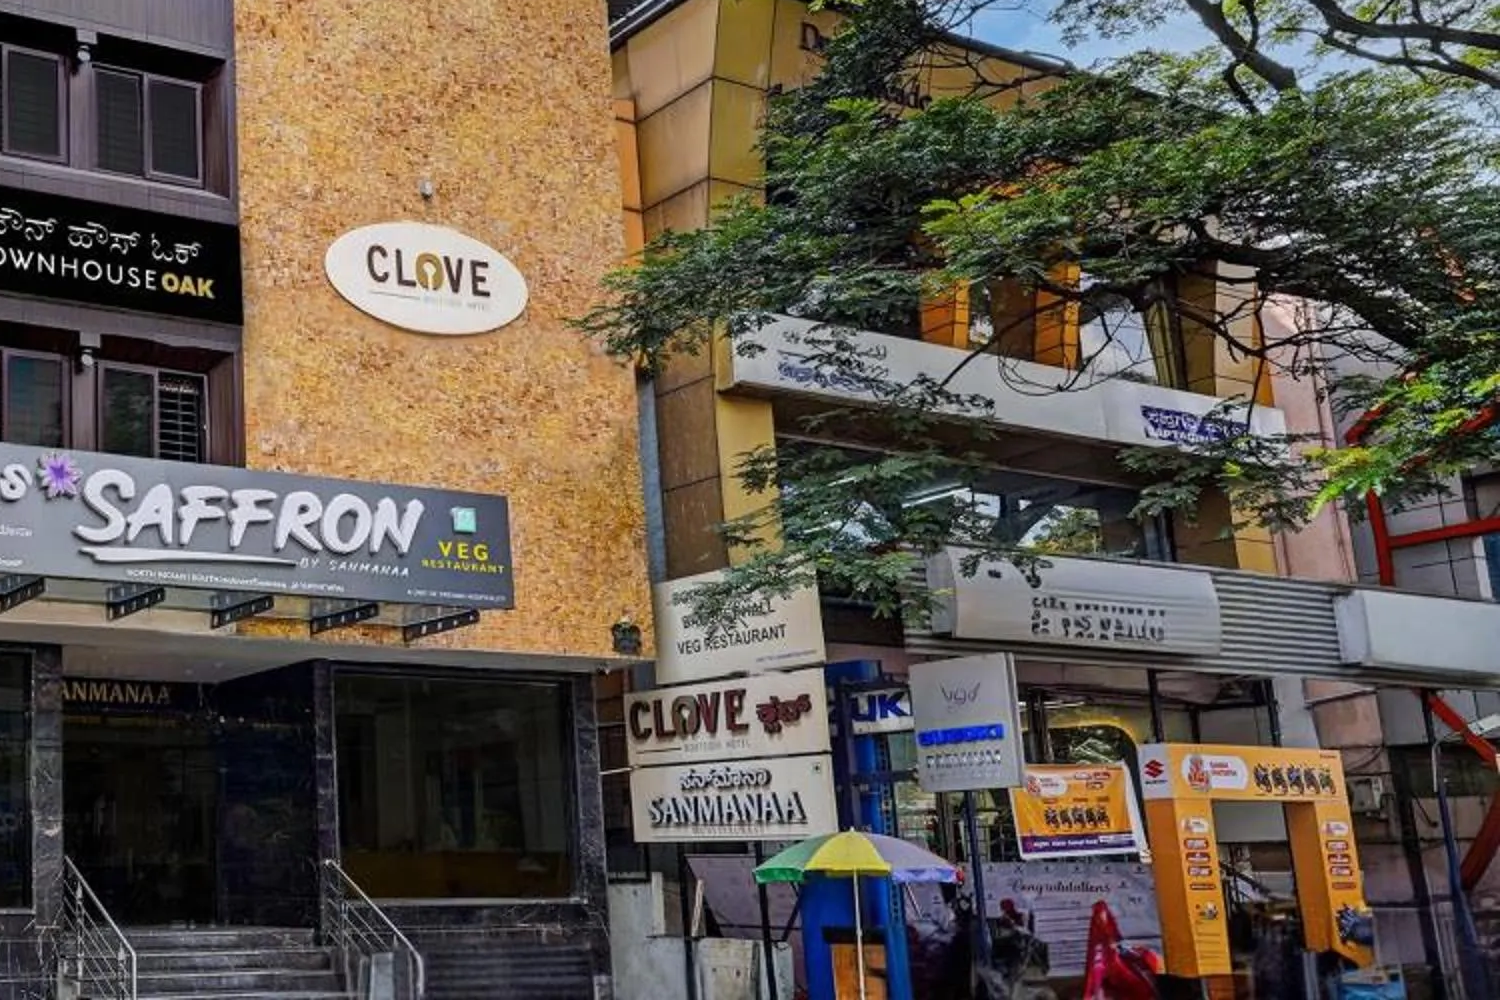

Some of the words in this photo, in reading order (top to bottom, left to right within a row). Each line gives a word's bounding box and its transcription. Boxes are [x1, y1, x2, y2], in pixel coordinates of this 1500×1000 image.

[366, 242, 491, 297] CLOVE
[71, 468, 426, 556] SAFFRON
[299, 558, 319, 569] BY
[420, 558, 505, 575] RESTAURANT
[438, 541, 489, 562] VEG
[676, 638, 701, 655] VEG
[703, 623, 787, 652] RESTAURANT
[60, 681, 173, 706] ANMANAA
[629, 688, 749, 741] CLOVE
[649, 791, 808, 827] SANMANAA
